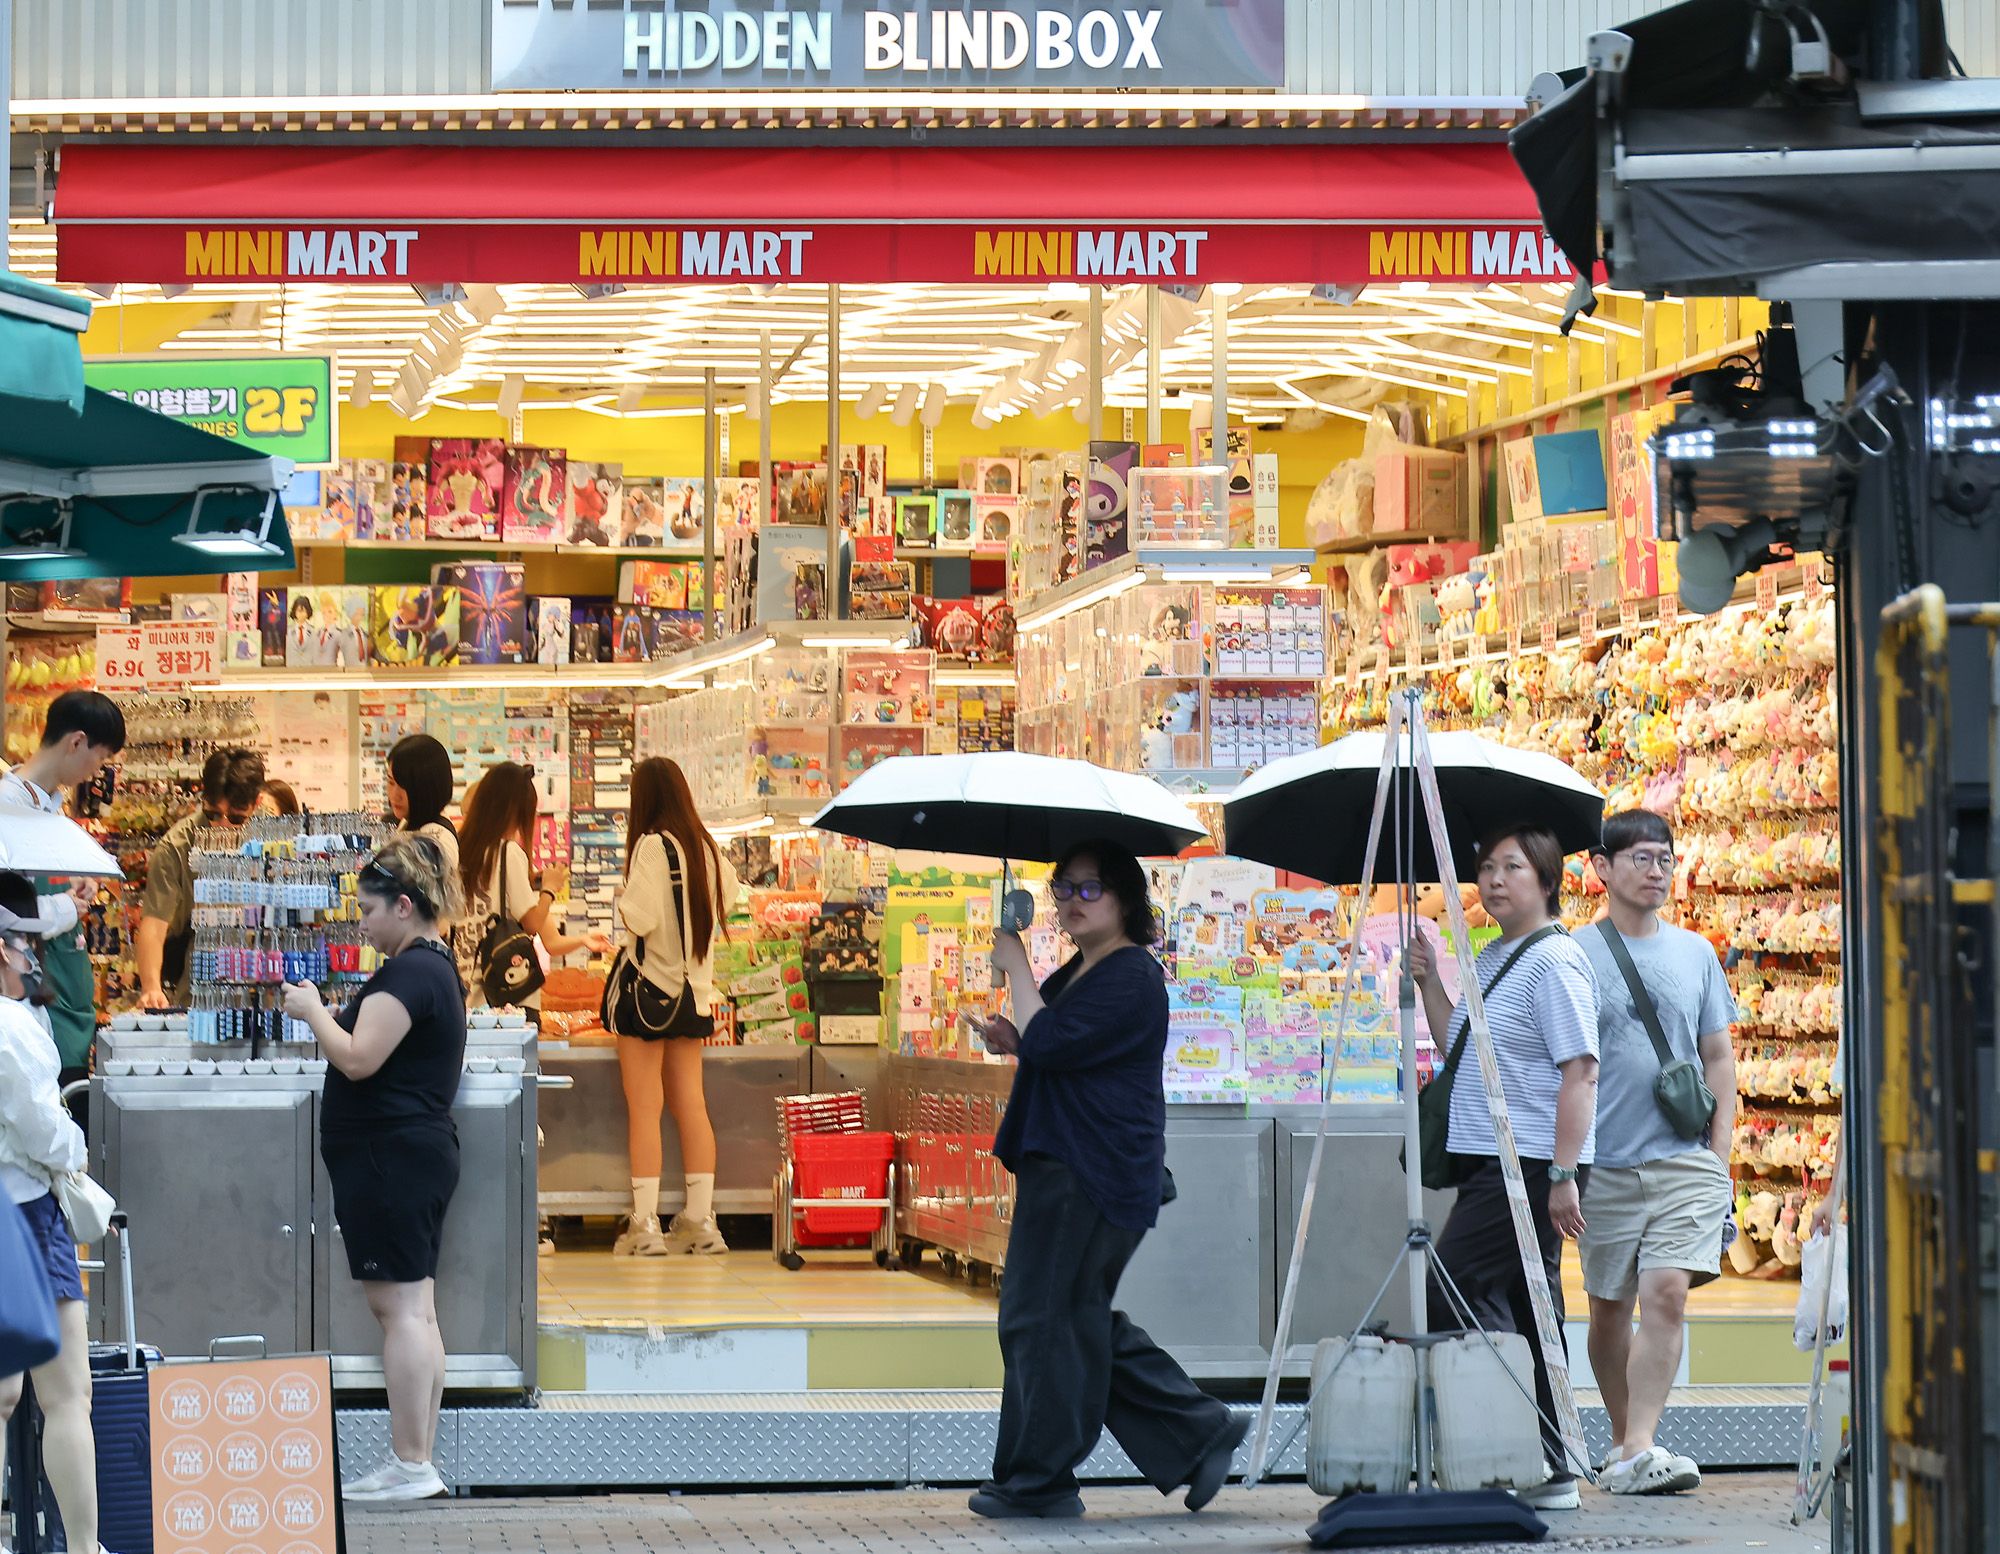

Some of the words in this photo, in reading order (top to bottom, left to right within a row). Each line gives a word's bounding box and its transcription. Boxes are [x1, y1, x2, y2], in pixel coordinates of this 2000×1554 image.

[623, 11, 832, 70] HIDDEN
[1369, 231, 1572, 275] MINIMAR
[243, 386, 317, 434] 2F
[156, 650, 212, 676] 정찰가
[1264, 898, 1284, 909] TOY
[224, 1391, 256, 1404] TAX
[278, 1388, 310, 1401] TAX
[170, 1395, 201, 1407] TAX
[280, 1401, 311, 1412] FREE
[171, 1407, 202, 1419] FREE
[226, 1404, 257, 1416] FREE
[172, 1450, 202, 1463] TAX
[226, 1447, 257, 1460] TAX
[280, 1444, 312, 1457] TAX
[173, 1463, 203, 1475] FREE
[227, 1460, 258, 1472] FREE
[282, 1457, 313, 1469] FREE
[228, 1503, 259, 1516] TAX
[283, 1500, 314, 1513] TAX
[173, 1507, 204, 1519] TAX
[284, 1513, 315, 1525] FREE
[174, 1519, 205, 1531] FREE
[229, 1516, 260, 1528] FREE
